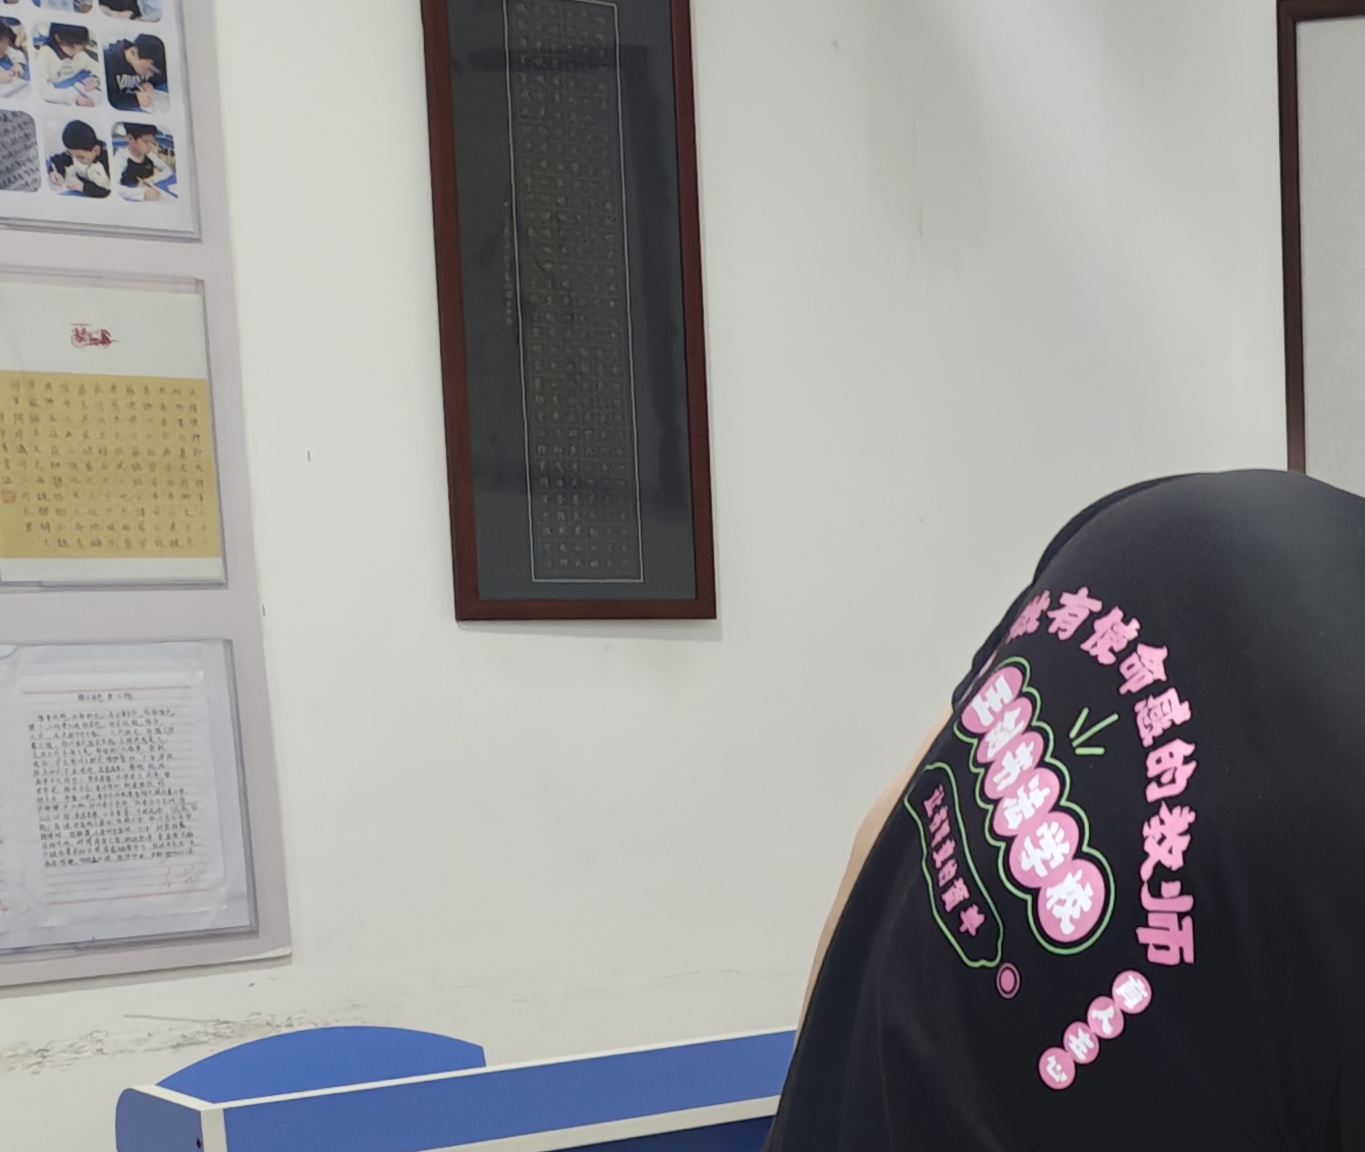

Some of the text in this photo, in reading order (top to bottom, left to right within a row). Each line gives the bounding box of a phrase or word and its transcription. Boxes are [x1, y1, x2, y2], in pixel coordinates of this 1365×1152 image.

[971, 673, 1095, 936] 王剑书法学校
